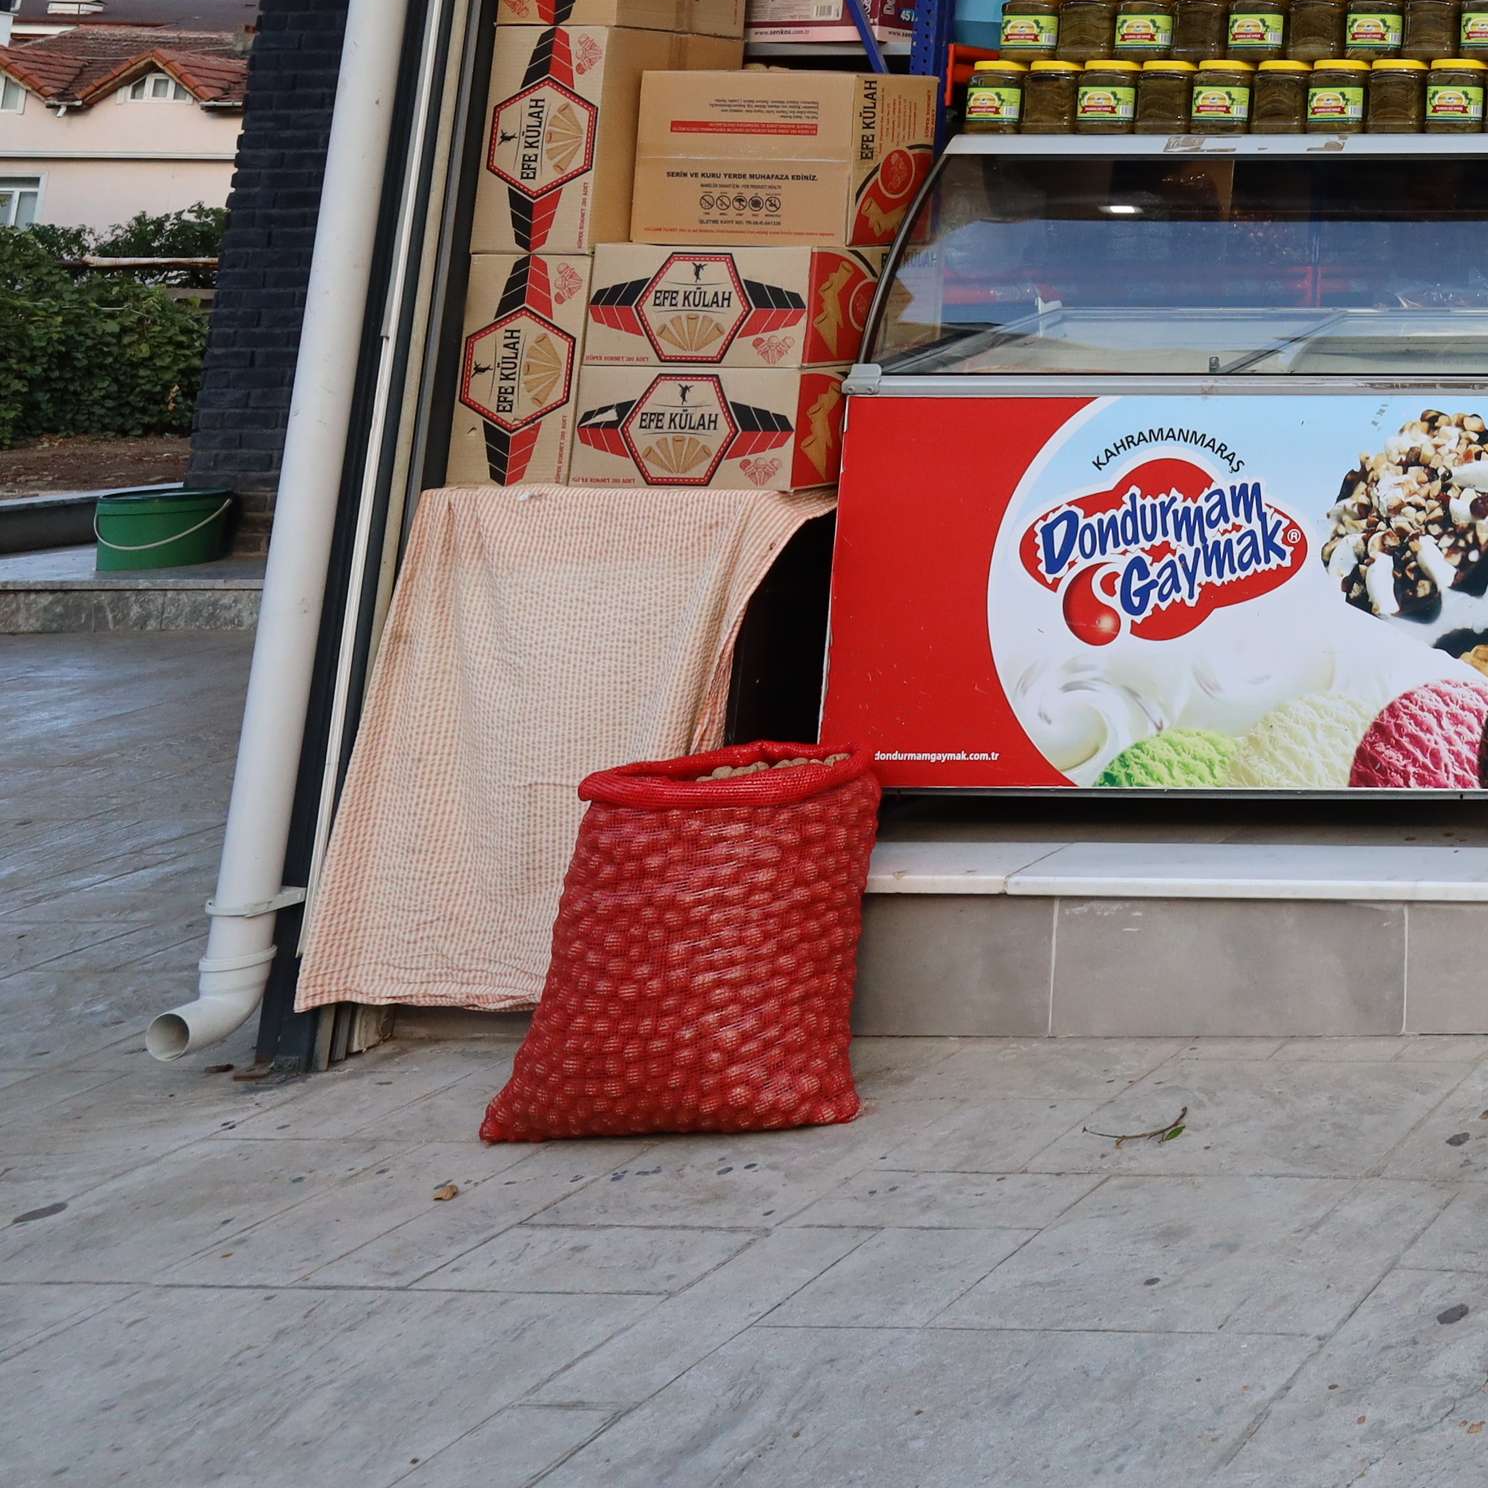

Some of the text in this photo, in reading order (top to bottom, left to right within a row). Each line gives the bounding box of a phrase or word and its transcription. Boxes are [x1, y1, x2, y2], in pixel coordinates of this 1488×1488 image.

[521, 98, 546, 180] EFE KÜLAH
[859, 80, 877, 161] EFE KÜLAH
[690, 171, 699, 179] VE
[723, 172, 747, 180] YERDE
[749, 173, 789, 181] MUHAFAZA
[653, 287, 732, 308] EFE KÜLAH
[496, 329, 521, 413] EFE KÜLAH
[639, 409, 719, 431] EFE KÜLAH
[1092, 427, 1245, 473] KAHRAMANMARAŞ
[1041, 482, 1263, 577] Dondurmam
[1120, 512, 1287, 616] Gaymak
[875, 751, 999, 763] dondurmamgaymak.com.tr
